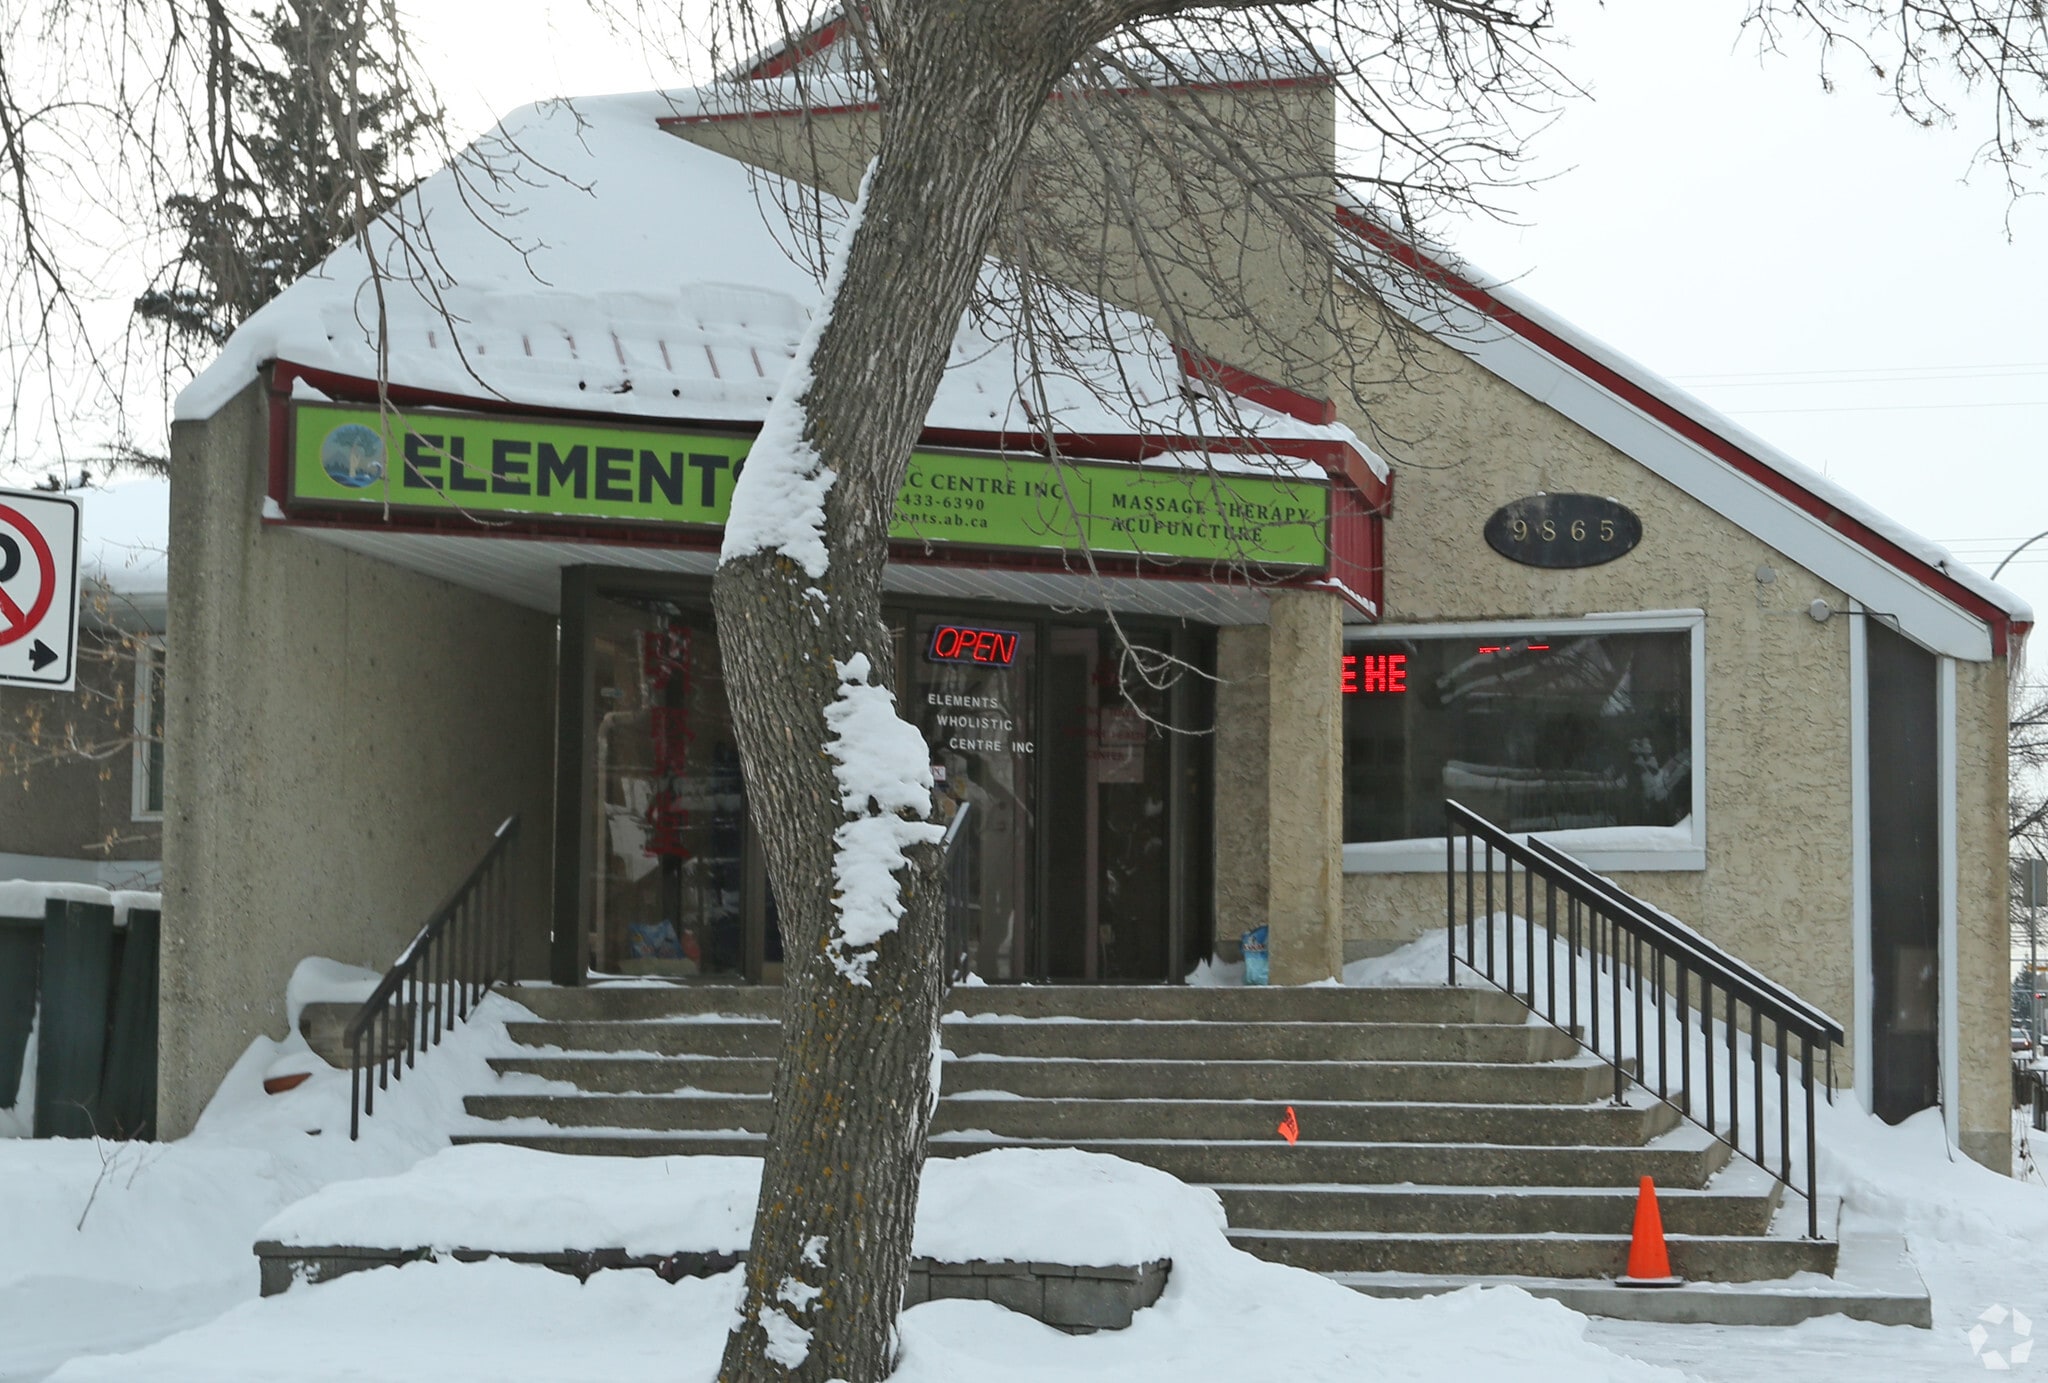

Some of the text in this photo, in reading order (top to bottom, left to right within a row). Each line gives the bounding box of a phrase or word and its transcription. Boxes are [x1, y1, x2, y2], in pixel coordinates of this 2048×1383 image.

[403, 433, 747, 508] ELEMENT
[931, 474, 1016, 496] CENTRE
[1112, 493, 1310, 522] MASSAGE THERAPY
[893, 512, 988, 529] ents.ab.ca
[1111, 517, 1263, 542] ACUPUNCTURE
[1512, 519, 1615, 542] 9865
[934, 627, 1016, 664] OPEN
[1364, 655, 1407, 692] HE
[928, 693, 999, 709] ELEMENTS
[936, 715, 1013, 732] WHOLISTIC
[949, 738, 1034, 754] CENTRE INC
